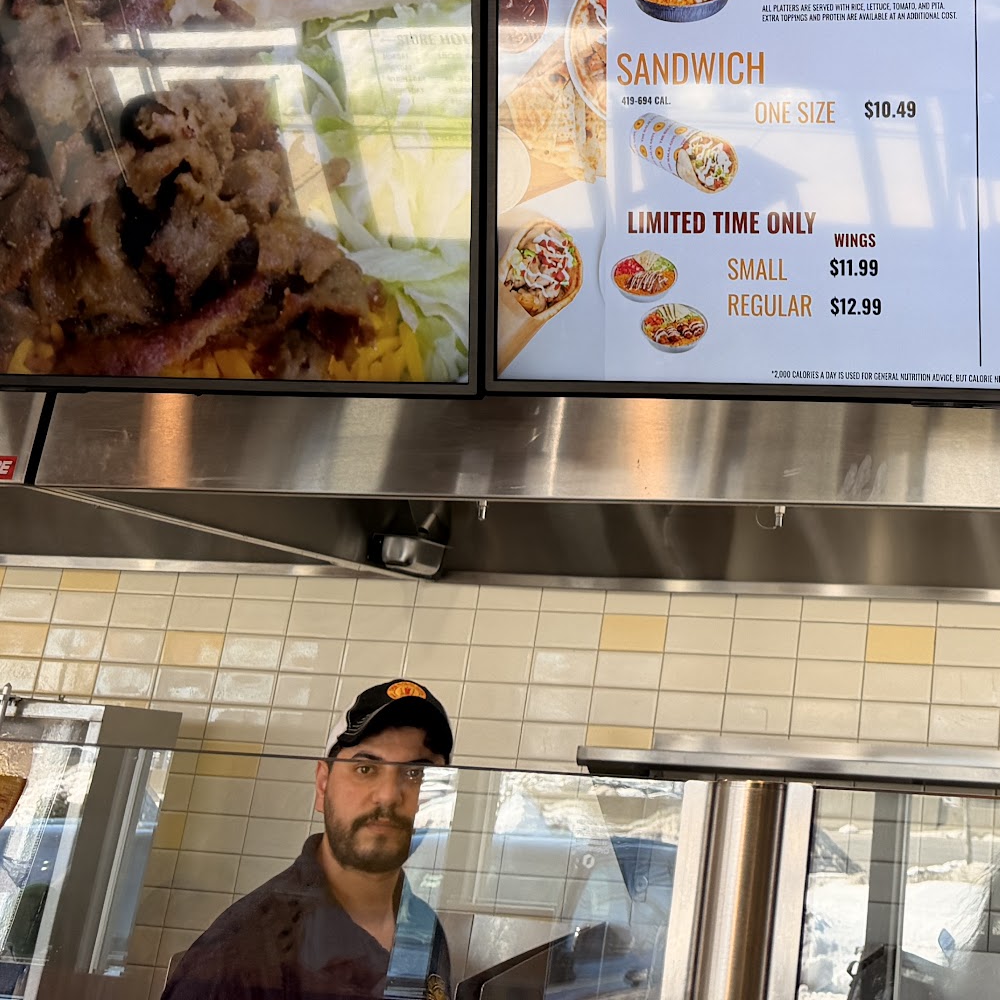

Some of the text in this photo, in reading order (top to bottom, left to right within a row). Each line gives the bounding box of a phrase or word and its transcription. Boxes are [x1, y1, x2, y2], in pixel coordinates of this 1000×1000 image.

[762, 4, 772, 12] ALL
[773, 4, 800, 12] PLATTERS
[801, 4, 811, 12] ARE
[813, 3, 834, 12] SERVED
[835, 3, 850, 11] WITH
[918, 2, 930, 10] AND
[762, 14, 779, 22] EXTRA
[781, 13, 808, 22] TOPPINGS
[809, 13, 821, 21] AND
[822, 13, 846, 21] PROTEIN
[846, 12, 858, 21] ARE
[858, 12, 888, 20] AVAILABLE
[906, 11, 940, 20] ADDITIONAL
[616, 51, 765, 86] SANDWICH
[621, 96, 672, 106] 419-694 CAL.
[755, 100, 917, 124] ONE SIZE $10.49
[627, 211, 817, 235] LIMITED TIME ONLY
[834, 233, 877, 248] WINGS
[727, 257, 879, 281] SMALL $11.99
[727, 293, 882, 317] REGULAR $12.99
[792, 370, 819, 379] CALORIES
[825, 371, 837, 379] DAY
[845, 372, 860, 380] USED
[861, 372, 873, 380] FOR
[873, 372, 898, 381] GENERAL
[900, 373, 931, 381] NUTRITION
[955, 374, 967, 382] BUT
[968, 374, 993, 383] CALORIE
